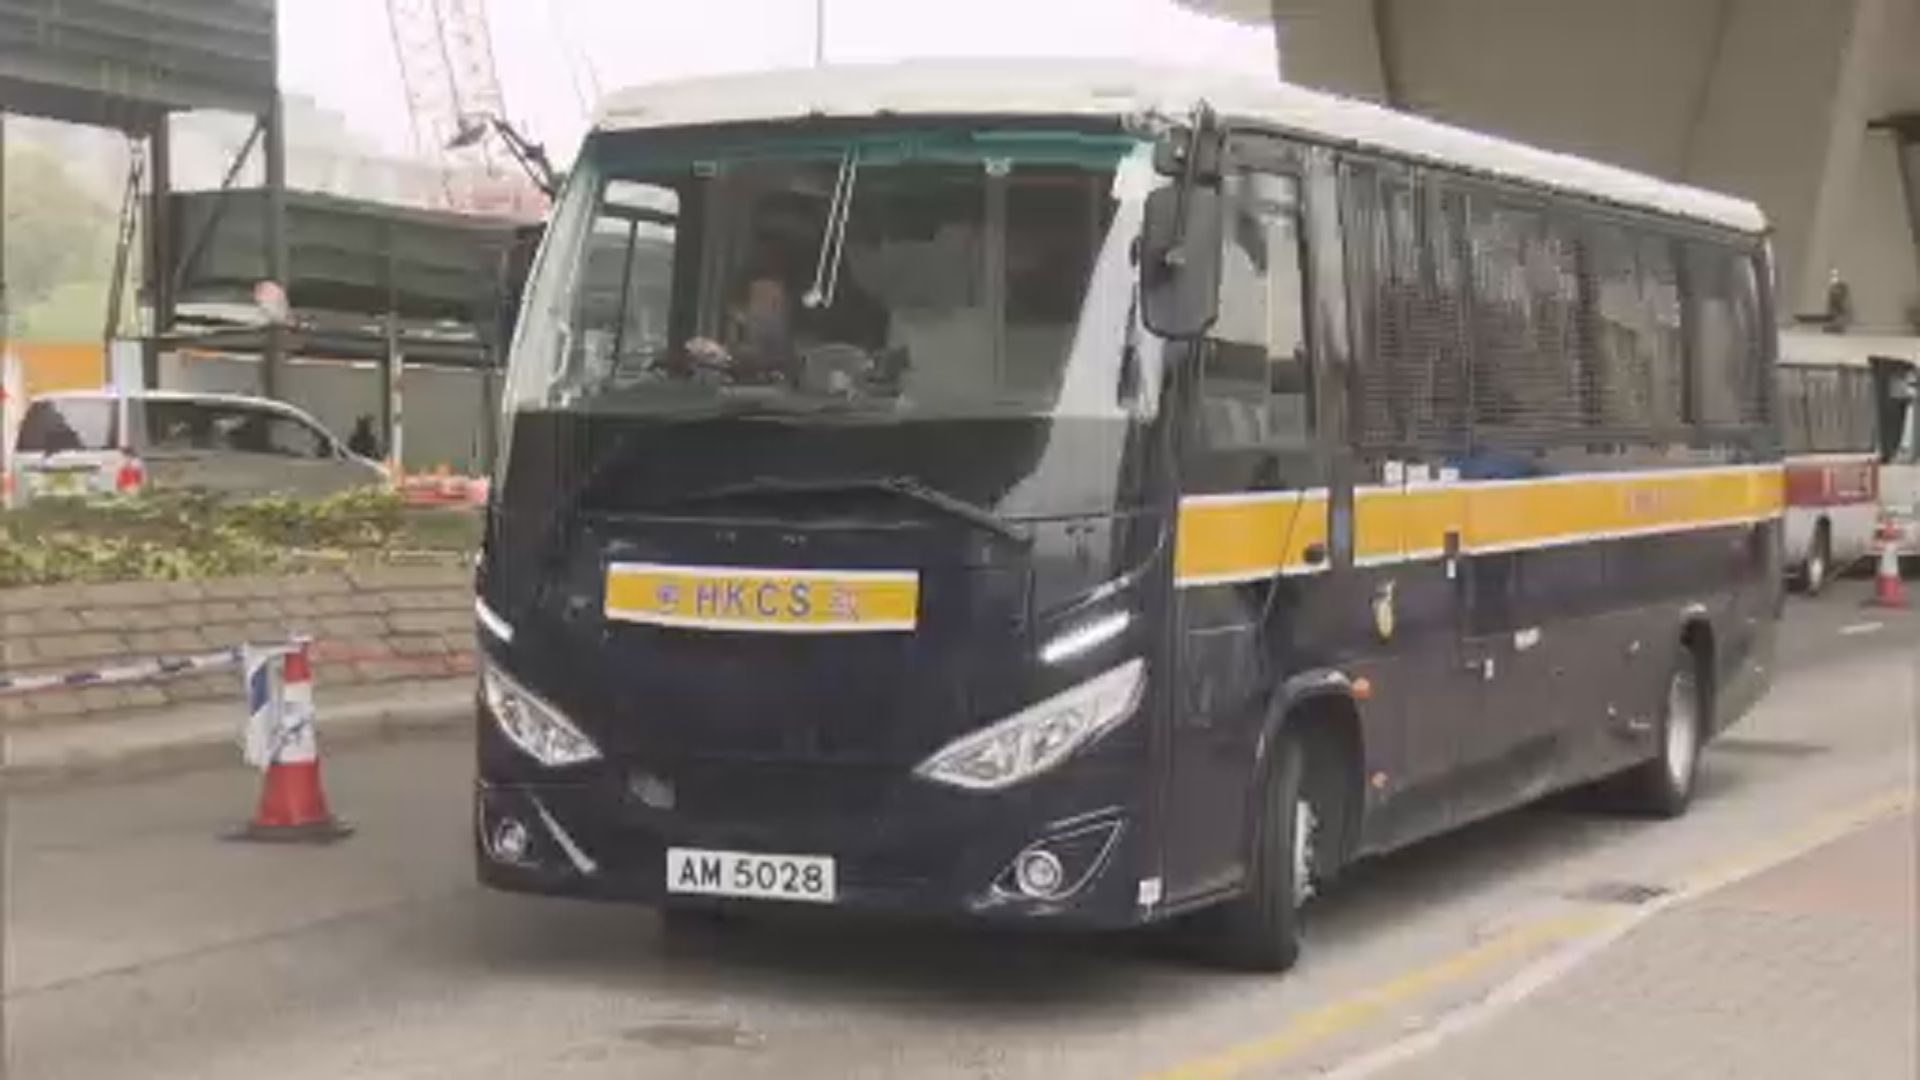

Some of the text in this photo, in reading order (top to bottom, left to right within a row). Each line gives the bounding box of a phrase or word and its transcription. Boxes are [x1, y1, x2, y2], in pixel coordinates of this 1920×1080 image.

[696, 580, 812, 617] HKCS
[679, 855, 823, 894] AM 5028
